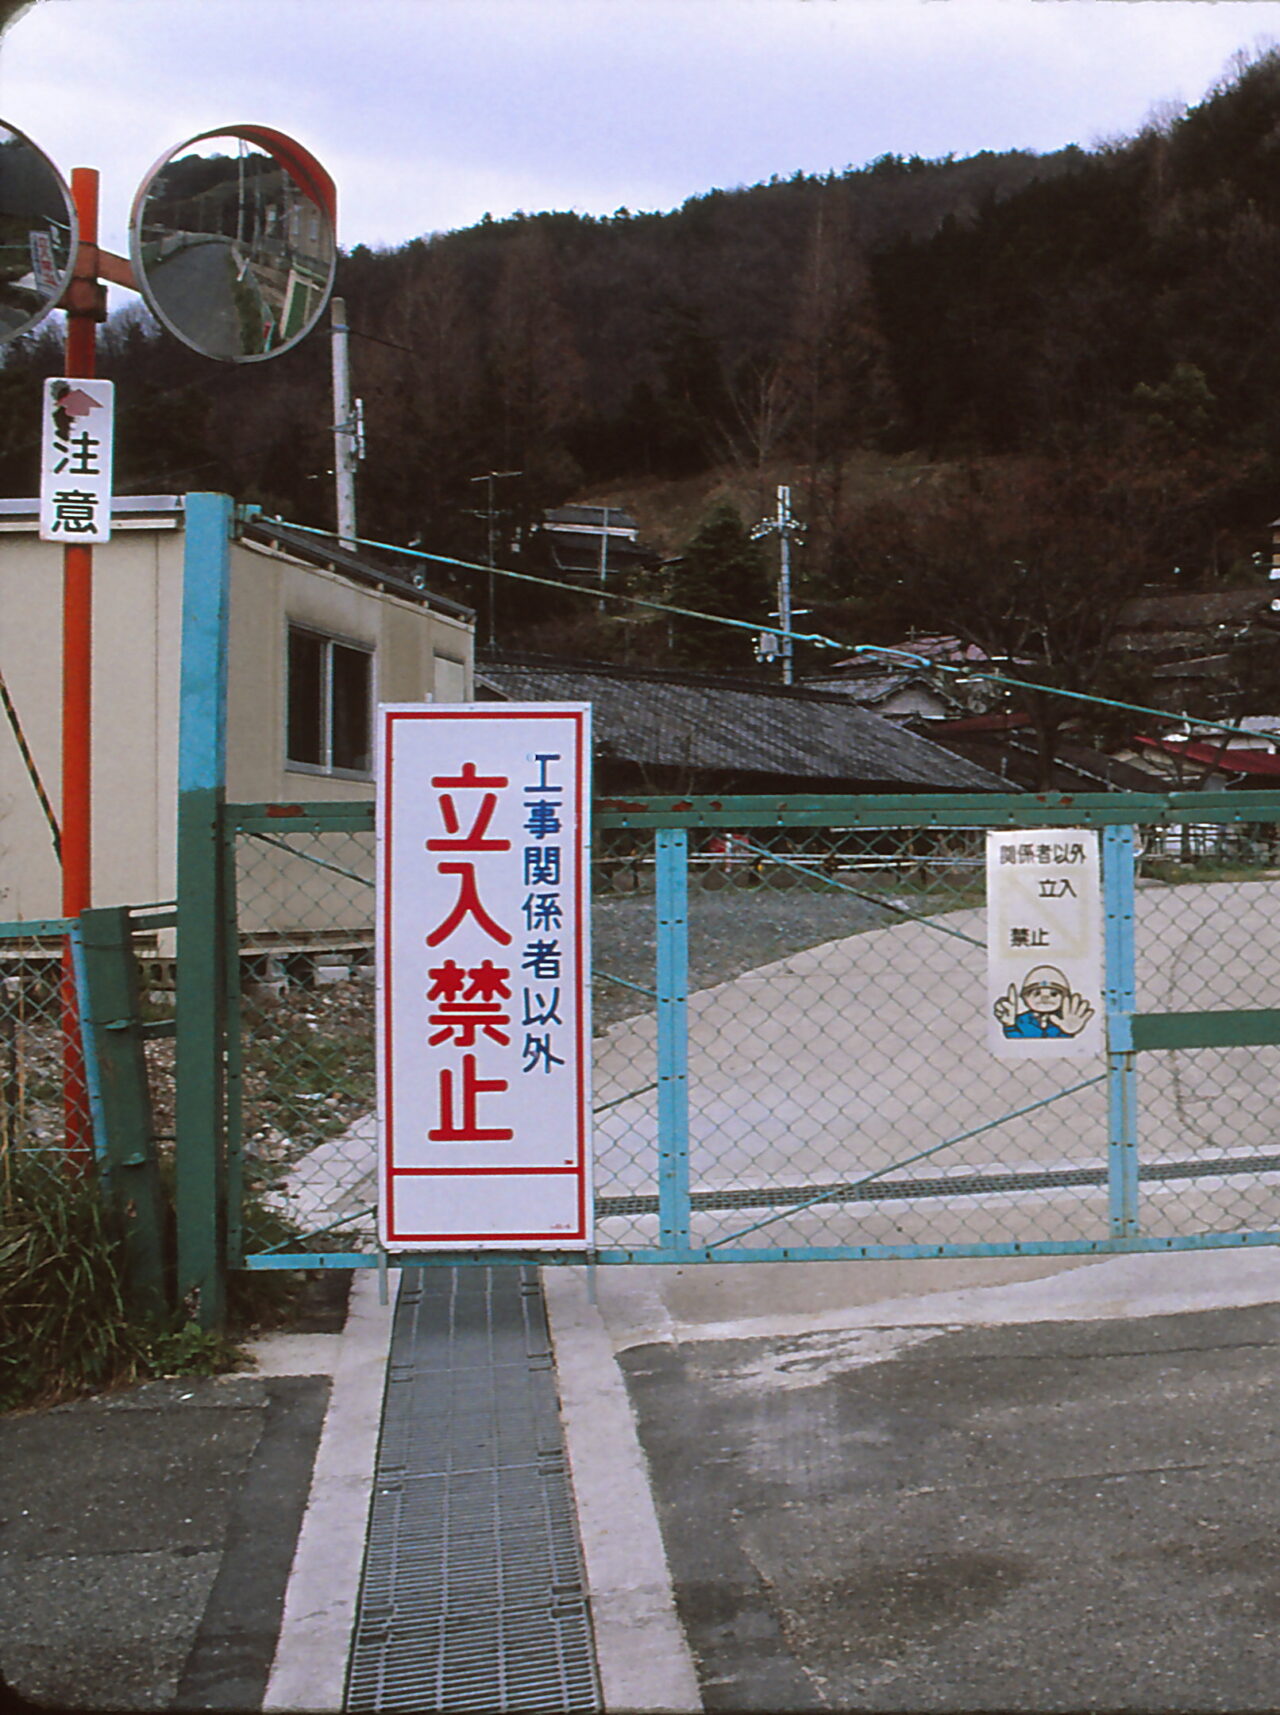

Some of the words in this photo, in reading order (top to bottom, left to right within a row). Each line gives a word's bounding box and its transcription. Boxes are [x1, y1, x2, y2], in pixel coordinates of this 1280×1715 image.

[52, 431, 99, 534] 注意
[1000, 843, 1086, 865] 関係者以外
[522, 753, 564, 1073] 工事関係者以外
[1038, 879, 1077, 898] 立入
[426, 762, 513, 1141] 立入禁止
[1010, 927, 1049, 947] 禁止
